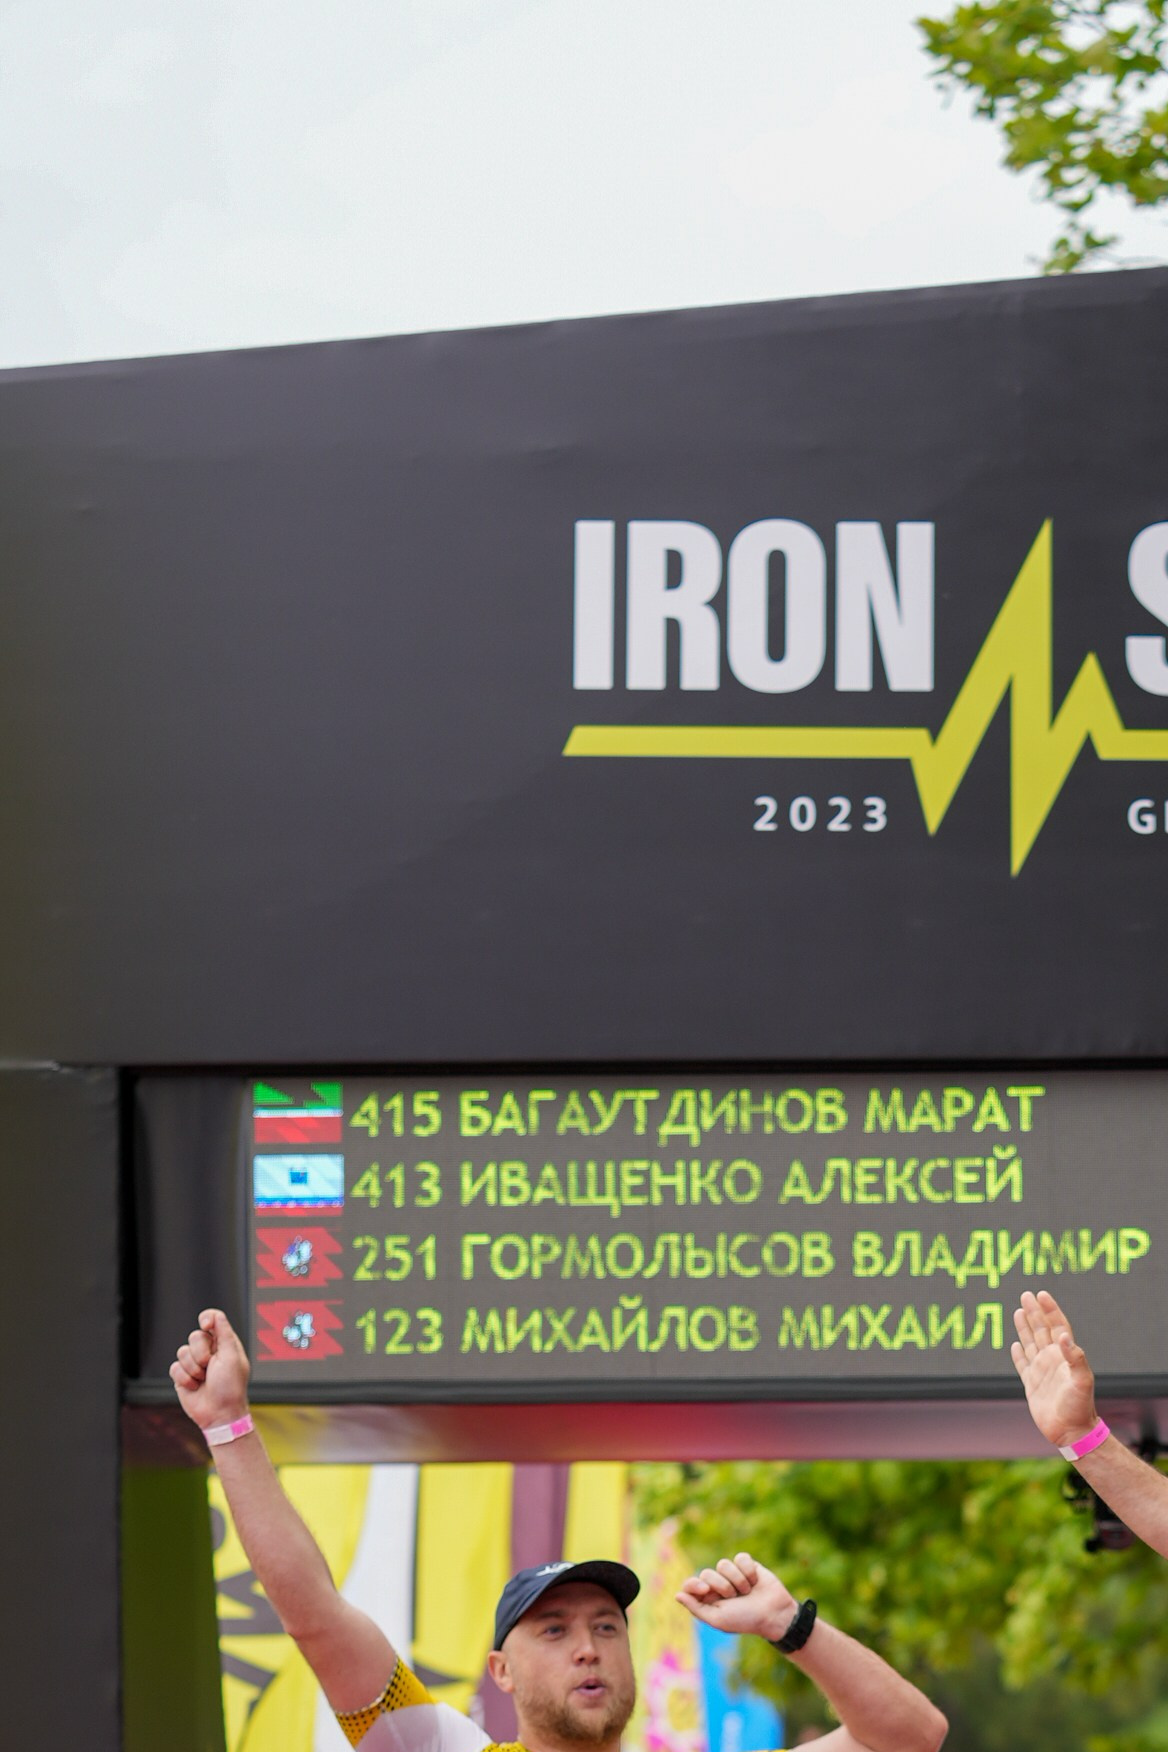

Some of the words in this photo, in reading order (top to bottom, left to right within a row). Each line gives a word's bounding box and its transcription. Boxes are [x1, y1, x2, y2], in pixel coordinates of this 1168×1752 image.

[573, 518, 935, 694] IRON
[752, 795, 890, 833] 2023
[350, 1091, 442, 1137] 415
[460, 1088, 847, 1147] БАГАУТДИНОВ
[864, 1086, 1045, 1133] МАРАТ
[351, 1161, 442, 1208] 413
[460, 1159, 763, 1217] ИВАЩЕНКО
[779, 1145, 1024, 1204] АЛЕКСЕЙ
[352, 1235, 438, 1281] 251
[461, 1231, 835, 1281] ГОРМОЛЫСОВ
[852, 1228, 1151, 1289] ВЛАДИМИР
[355, 1309, 444, 1355] 123
[461, 1294, 761, 1354] МИХАЙЛОВ
[777, 1303, 1004, 1352] МИХАИЛ
